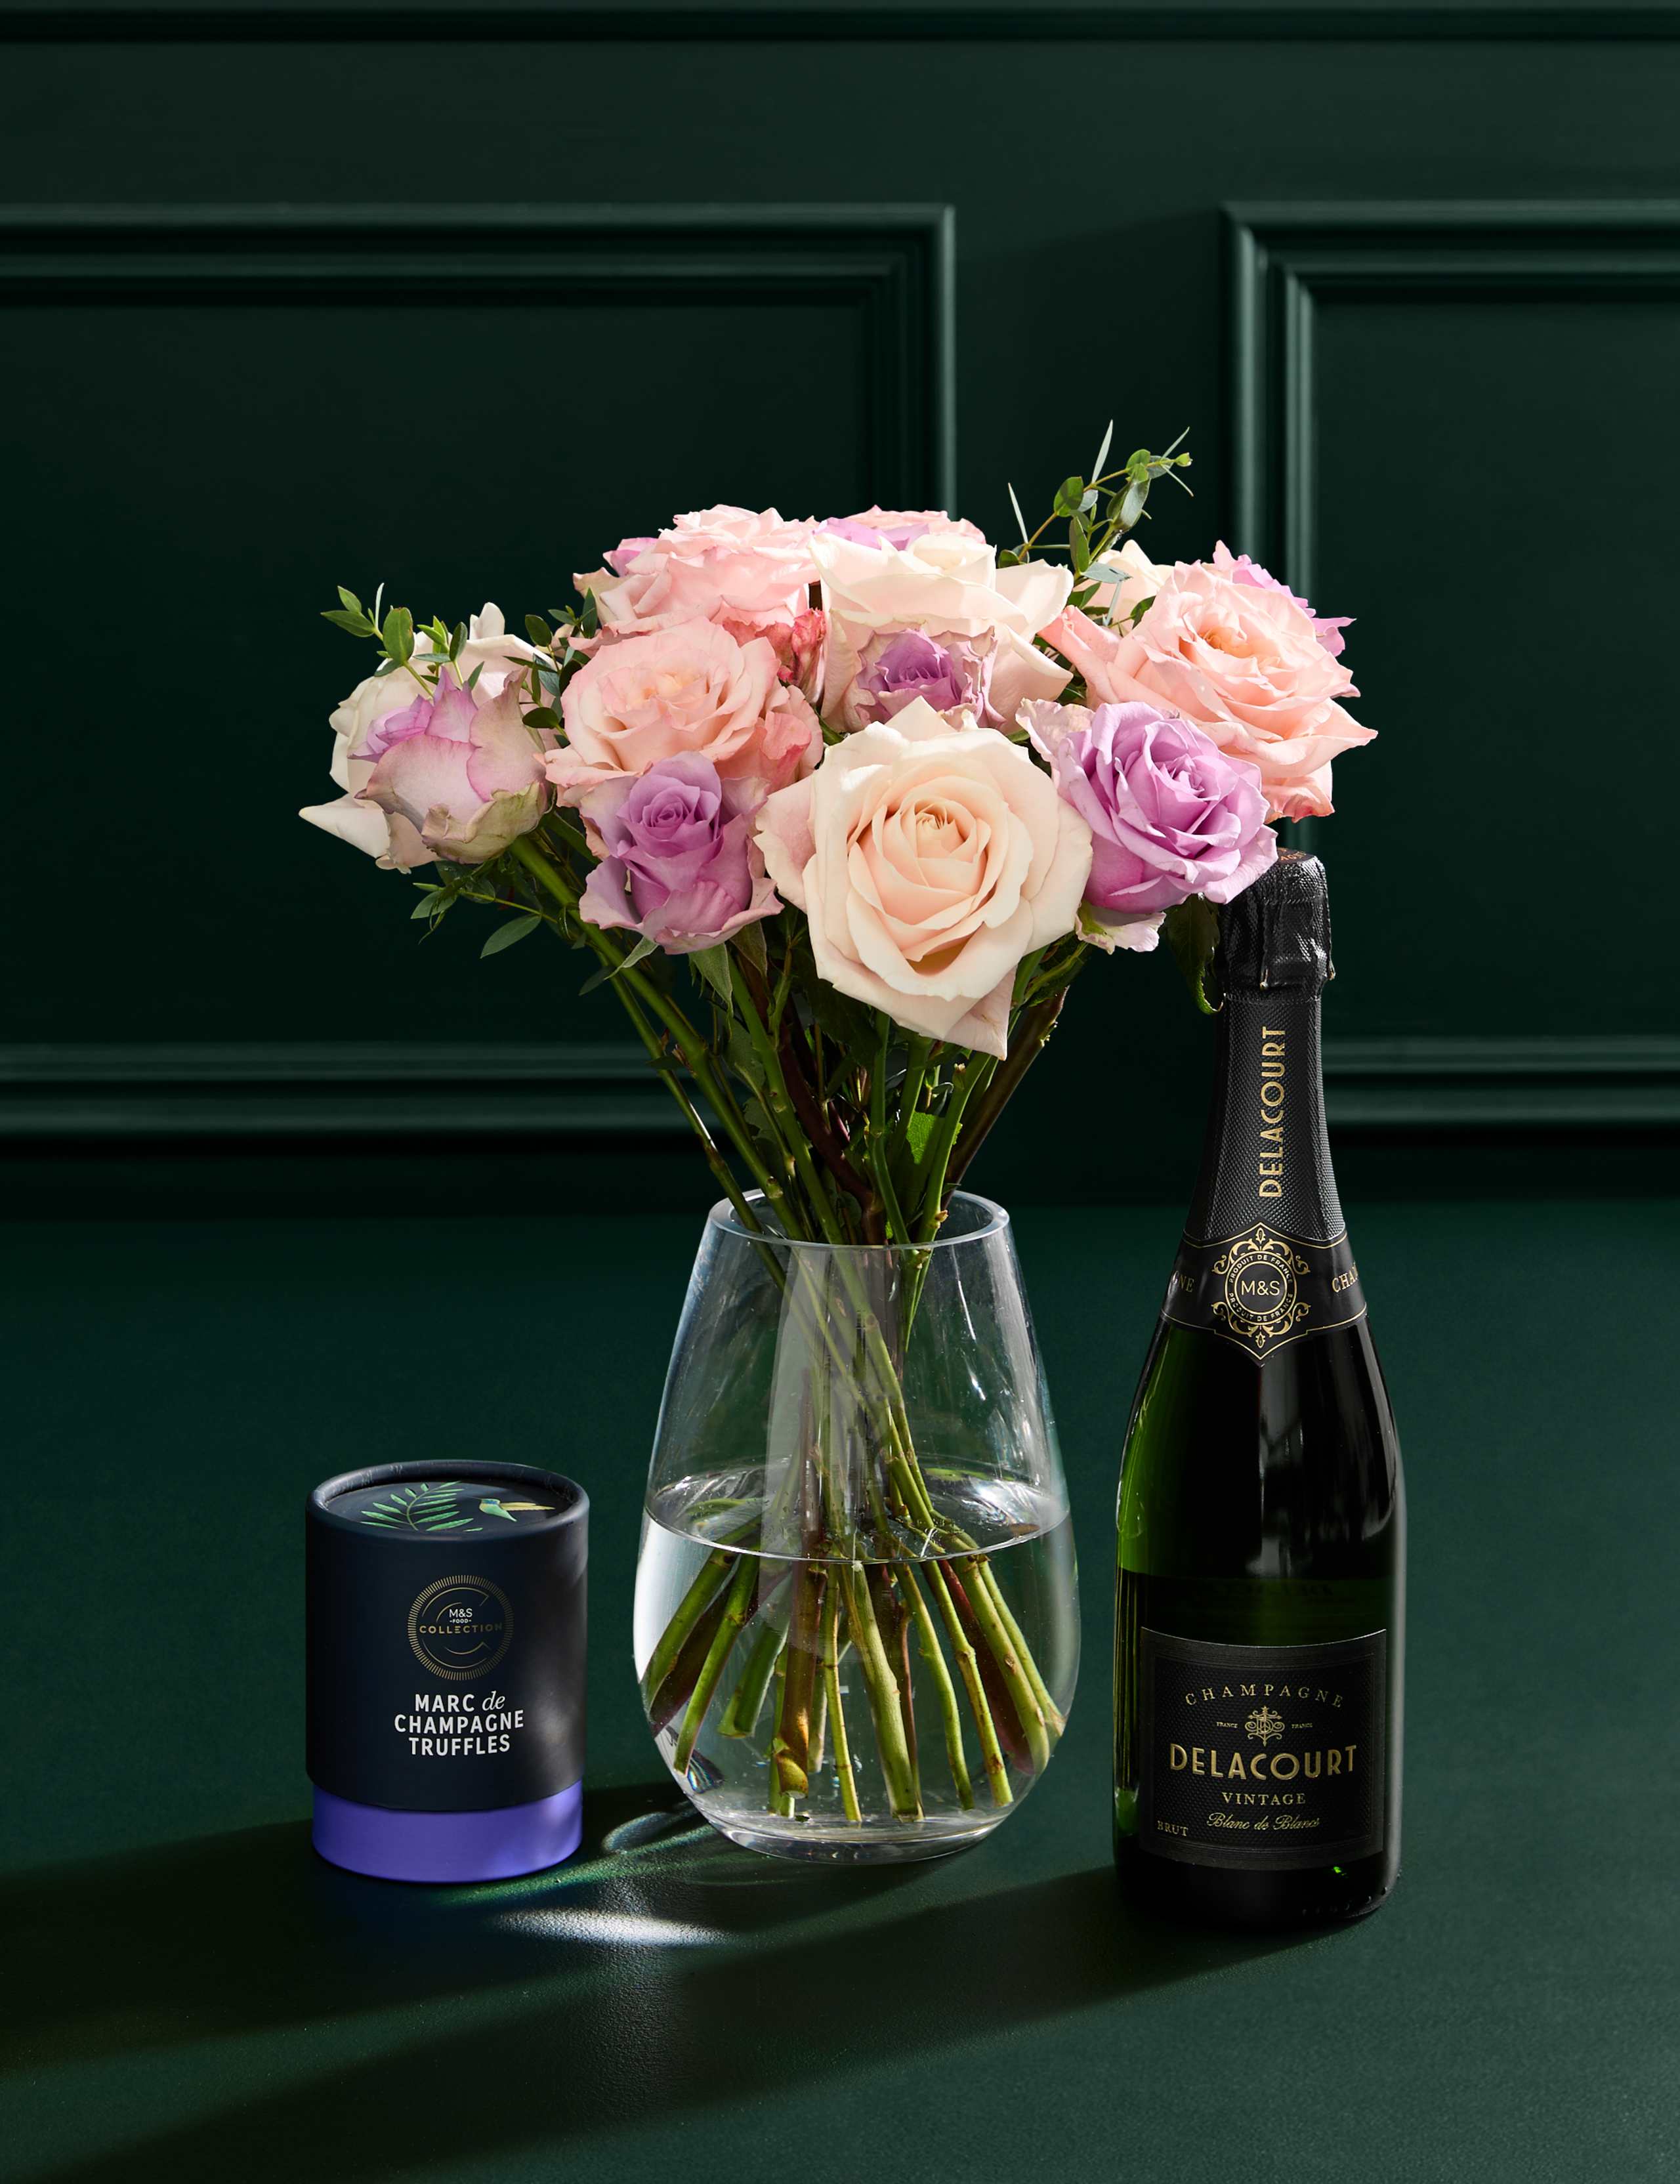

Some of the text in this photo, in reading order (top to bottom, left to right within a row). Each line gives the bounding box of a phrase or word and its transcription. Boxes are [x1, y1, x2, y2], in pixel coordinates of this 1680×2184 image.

[1259, 1026, 1286, 1197] DELACOURT
[1228, 1255, 1253, 1284] PRODUIT
[1270, 1257, 1293, 1283] FRANCE
[1241, 1280, 1280, 1296] M&S
[1228, 1292, 1254, 1320] PRODUIT
[1270, 1293, 1293, 1319] FRANCE
[449, 1608, 473, 1618] M&S
[419, 1622, 503, 1634] COLLECTION
[415, 1690, 506, 1713] MARC de
[1185, 1684, 1343, 1708] CHAMPAGNE
[394, 1710, 524, 1734] CHAMPAGNE
[408, 1734, 511, 1756] TRUFFLES
[1170, 1743, 1356, 1780] DELACOURT
[1222, 1792, 1306, 1805] VINTAGE
[1157, 1820, 1188, 1837] BRUT
[1207, 1813, 1320, 1830] Blanc de Blancs
